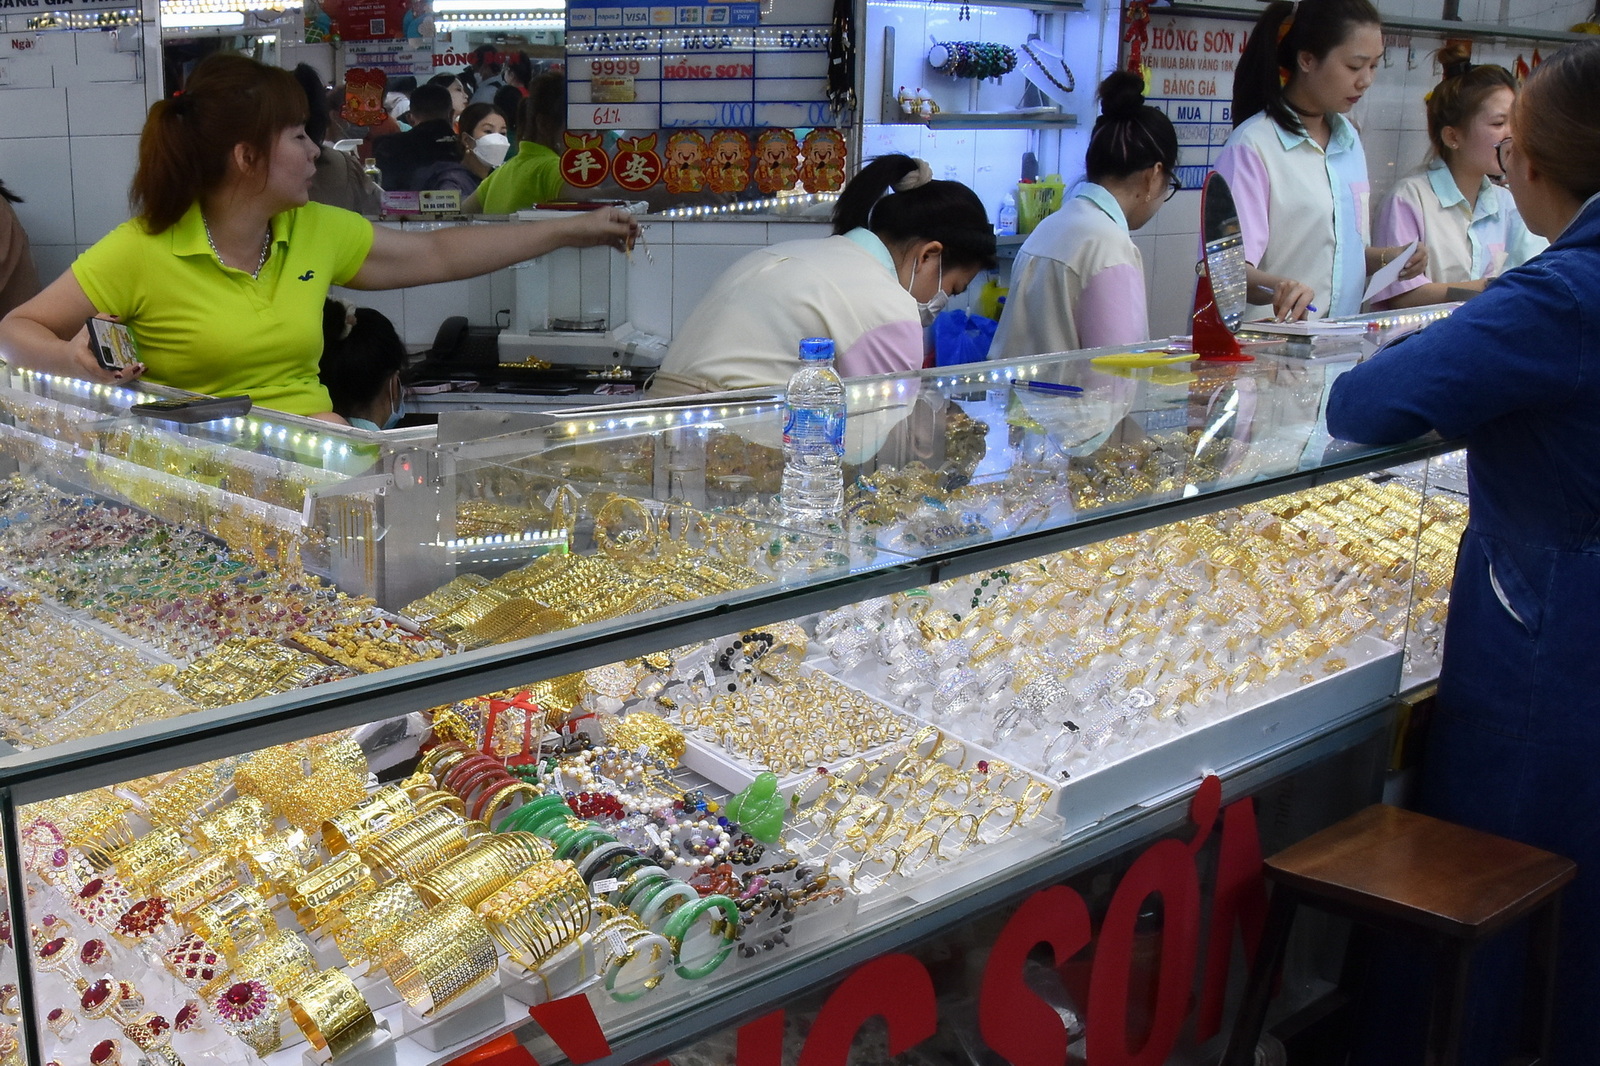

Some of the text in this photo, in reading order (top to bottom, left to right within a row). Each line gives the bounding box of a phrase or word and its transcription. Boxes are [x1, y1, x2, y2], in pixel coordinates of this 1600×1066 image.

[625, 13, 647, 22] VISA
[584, 33, 648, 51] VÀNG
[683, 34, 732, 50] MUA
[1151, 18, 1198, 52] HỒNG
[1203, 29, 1234, 53] SƠN
[431, 45, 479, 67] HỒNG
[1160, 58, 1178, 69] MUA
[1179, 56, 1196, 70] BÁN
[1197, 56, 1219, 71] VÀNG
[1221, 60, 1234, 72] 18K
[591, 60, 641, 76] 9999
[664, 58, 754, 79] HỒNG SƠN
[1163, 73, 1217, 96] BẢNG GIÁ
[593, 108, 621, 125] 61%
[1177, 106, 1202, 120] MUA
[567, 150, 602, 182] 平
[620, 153, 656, 184] 安
